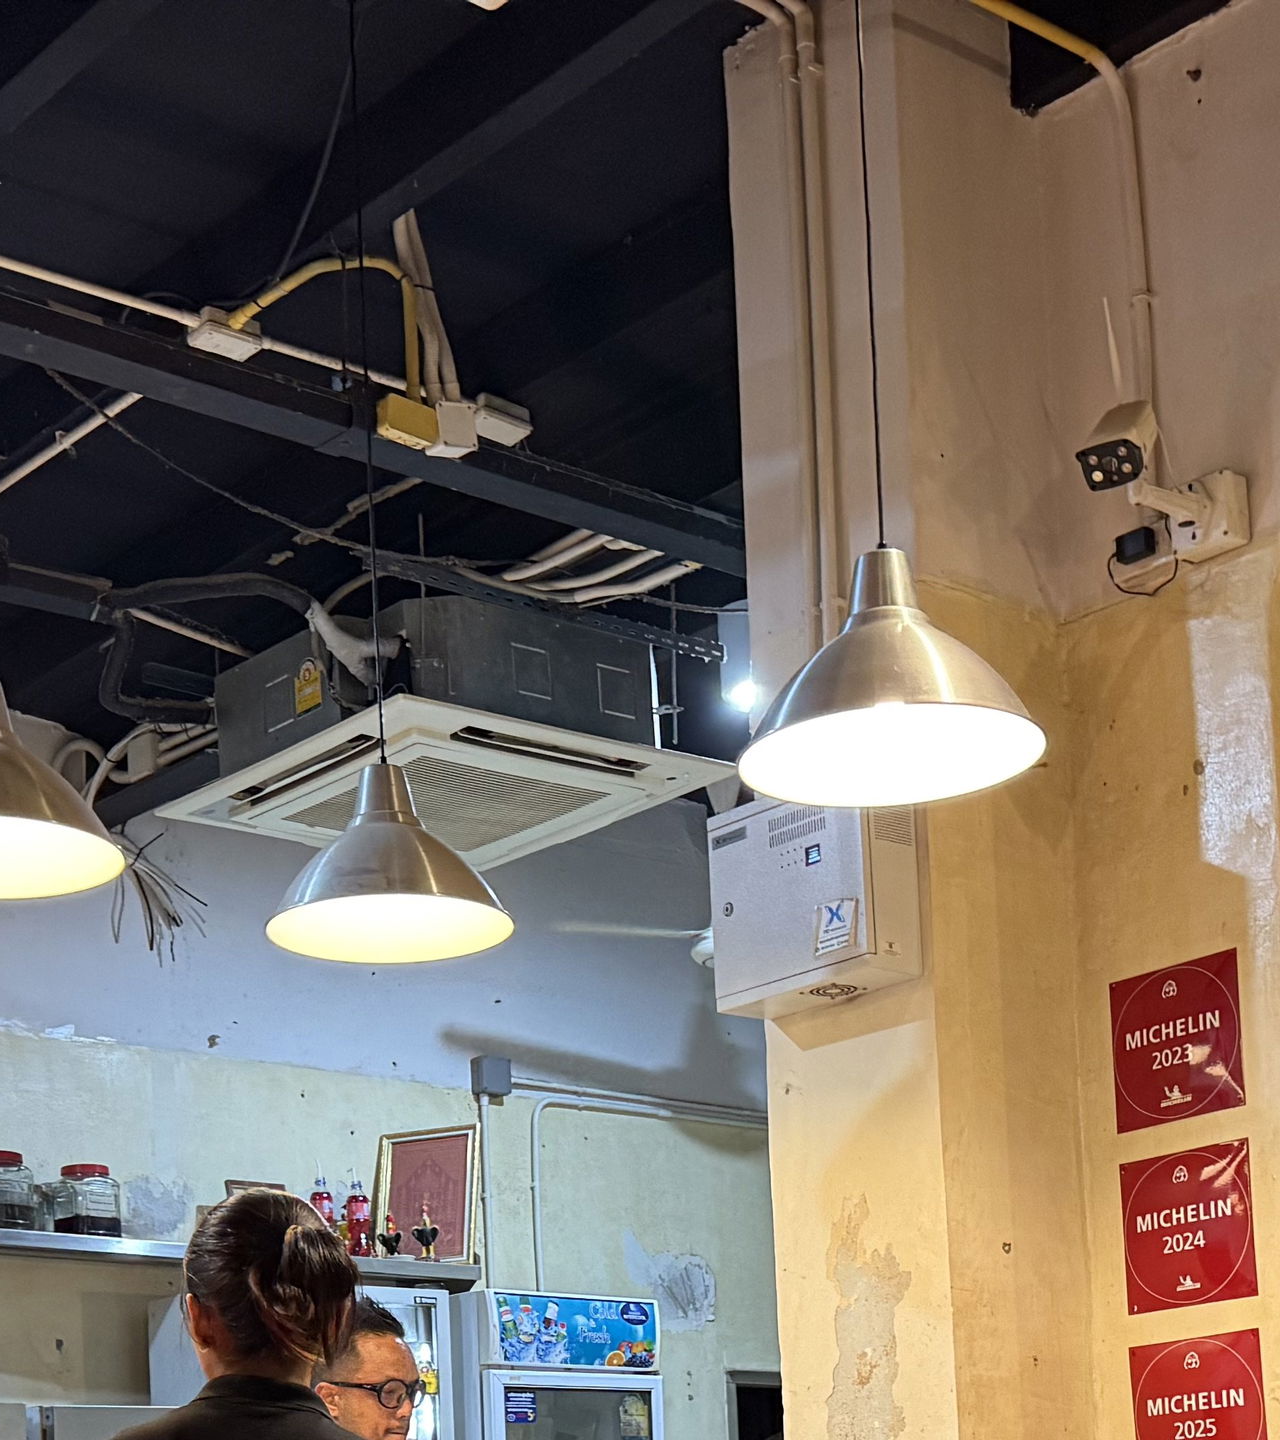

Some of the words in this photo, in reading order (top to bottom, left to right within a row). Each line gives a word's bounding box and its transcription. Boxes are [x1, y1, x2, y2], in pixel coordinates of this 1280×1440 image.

[1125, 1010, 1220, 1051] MICHELIN
[1152, 1043, 1193, 1070] 2023
[1136, 1198, 1233, 1234] MICHELIN
[1162, 1230, 1206, 1254] 2024
[1147, 1388, 1245, 1417] MICHELIN
[1174, 1418, 1217, 1440] 2025
